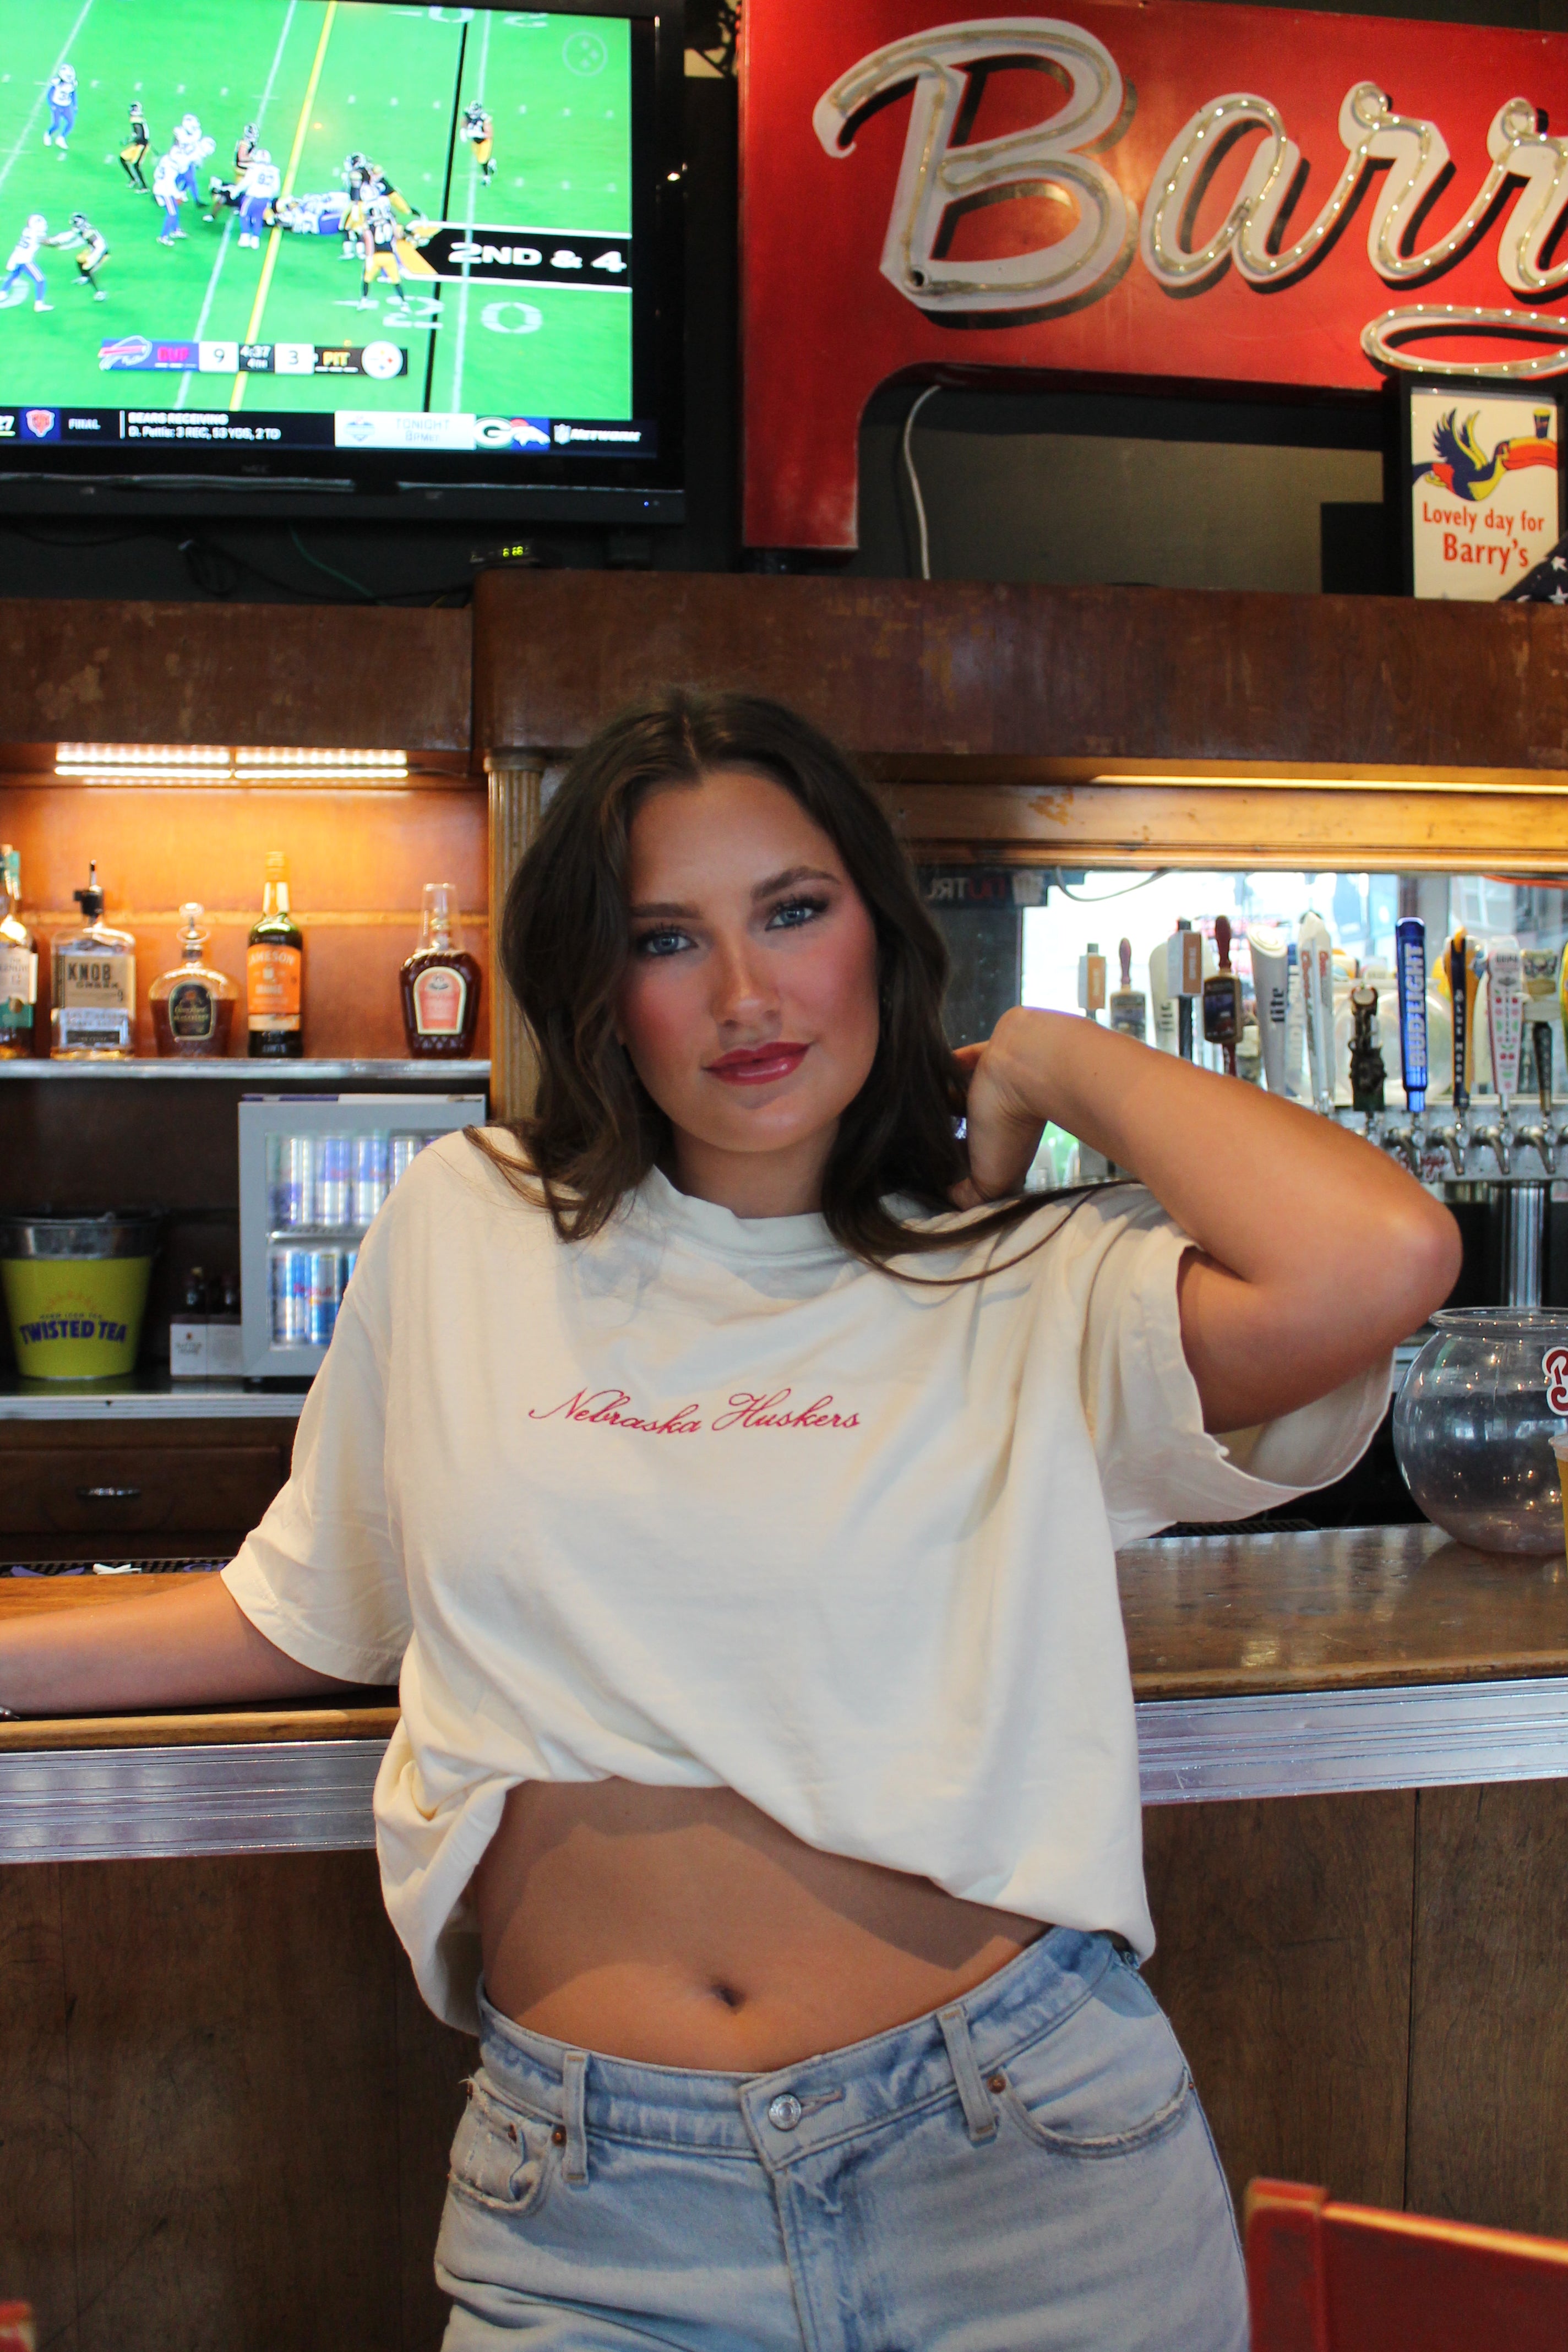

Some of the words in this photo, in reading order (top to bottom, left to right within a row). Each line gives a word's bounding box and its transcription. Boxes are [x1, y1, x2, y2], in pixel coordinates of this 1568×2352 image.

[448, 241, 542, 266] 2ND
[551, 249, 582, 269] &
[590, 251, 627, 273] 4
[213, 348, 225, 363] 9
[288, 350, 299, 365] 3
[323, 351, 351, 367] PIT
[396, 418, 450, 430] TONIGHT
[1423, 500, 1477, 533] Lovely
[1484, 508, 1515, 537] day
[1520, 510, 1545, 532] for
[1443, 532, 1529, 575] Barry's
[67, 963, 111, 980] KNOB
[1404, 943, 1426, 1014] LIGHT
[1408, 1017, 1427, 1067] BUD
[19, 1320, 95, 1344] TWISTED
[98, 1319, 128, 1343] TEA
[528, 1387, 702, 1434] Nebraska
[712, 1387, 861, 1431] Huskers
